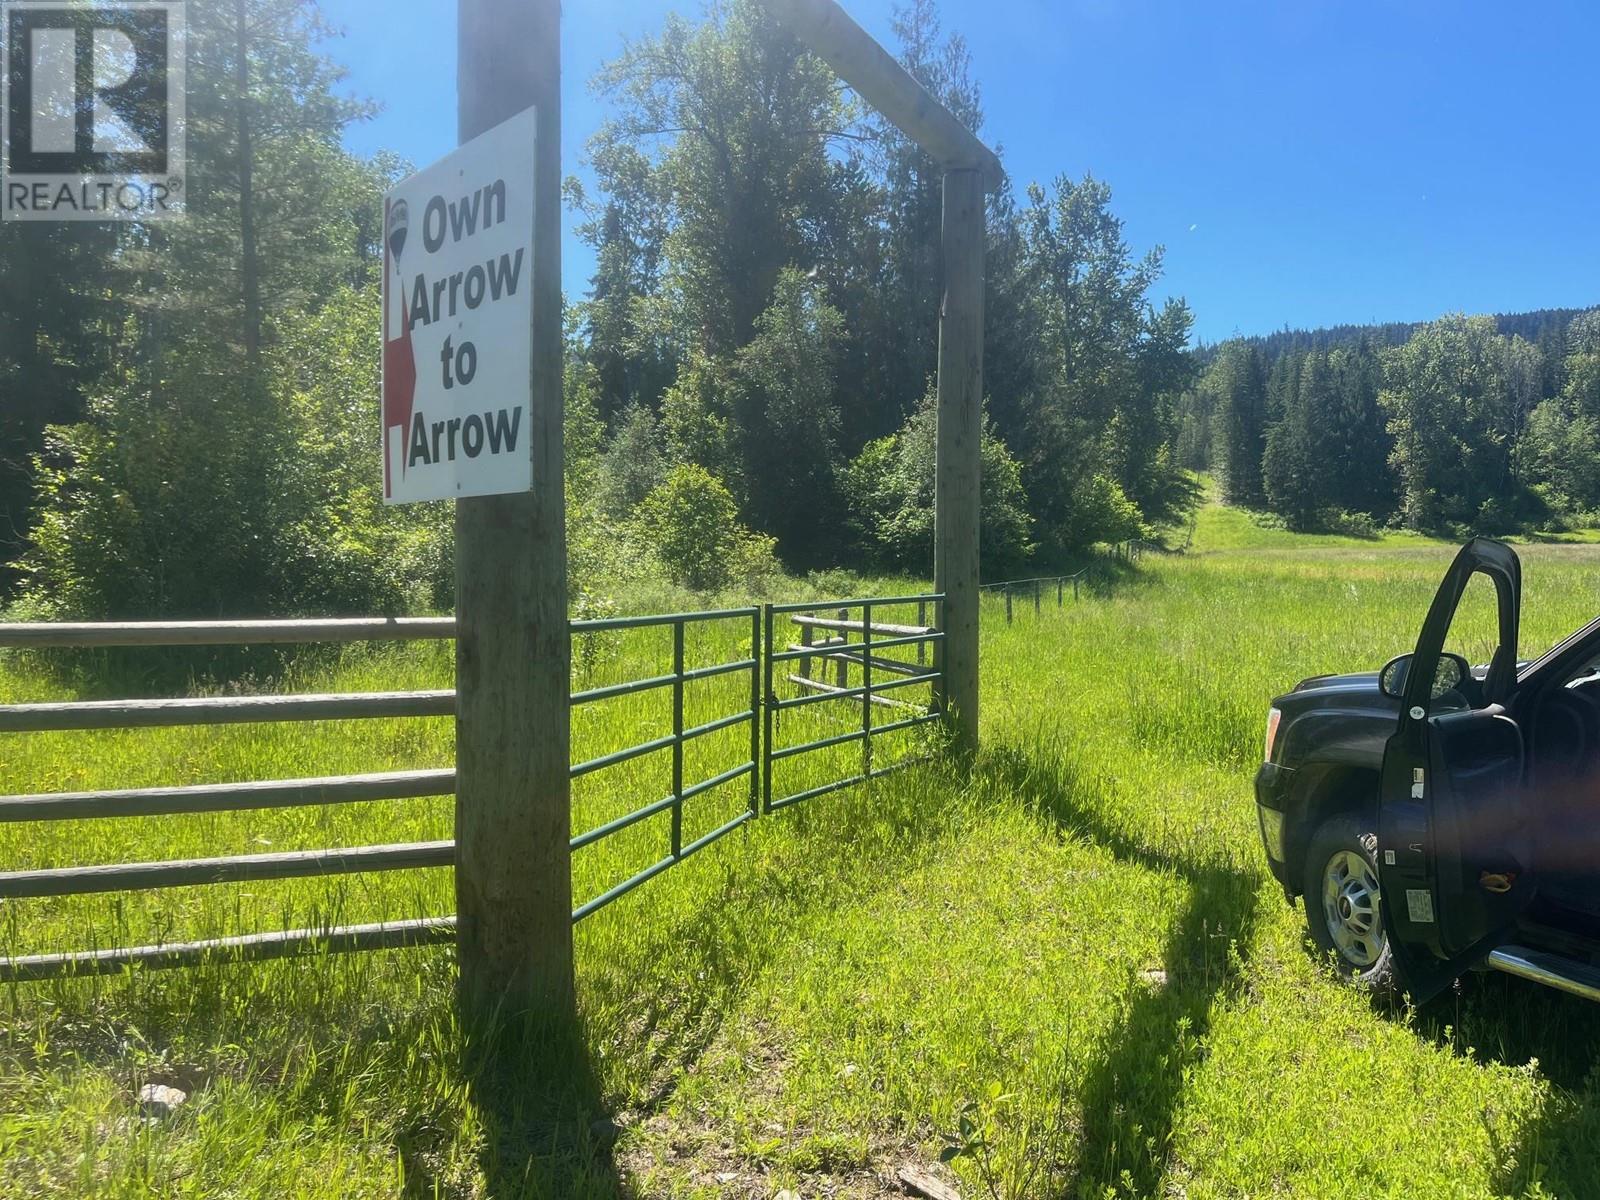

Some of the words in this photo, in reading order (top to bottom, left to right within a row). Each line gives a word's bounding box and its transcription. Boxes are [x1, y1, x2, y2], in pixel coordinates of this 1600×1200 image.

[423, 178, 506, 254] Own
[409, 247, 525, 331] Arrow
[440, 333, 477, 390] to
[408, 405, 523, 468] Arrow
